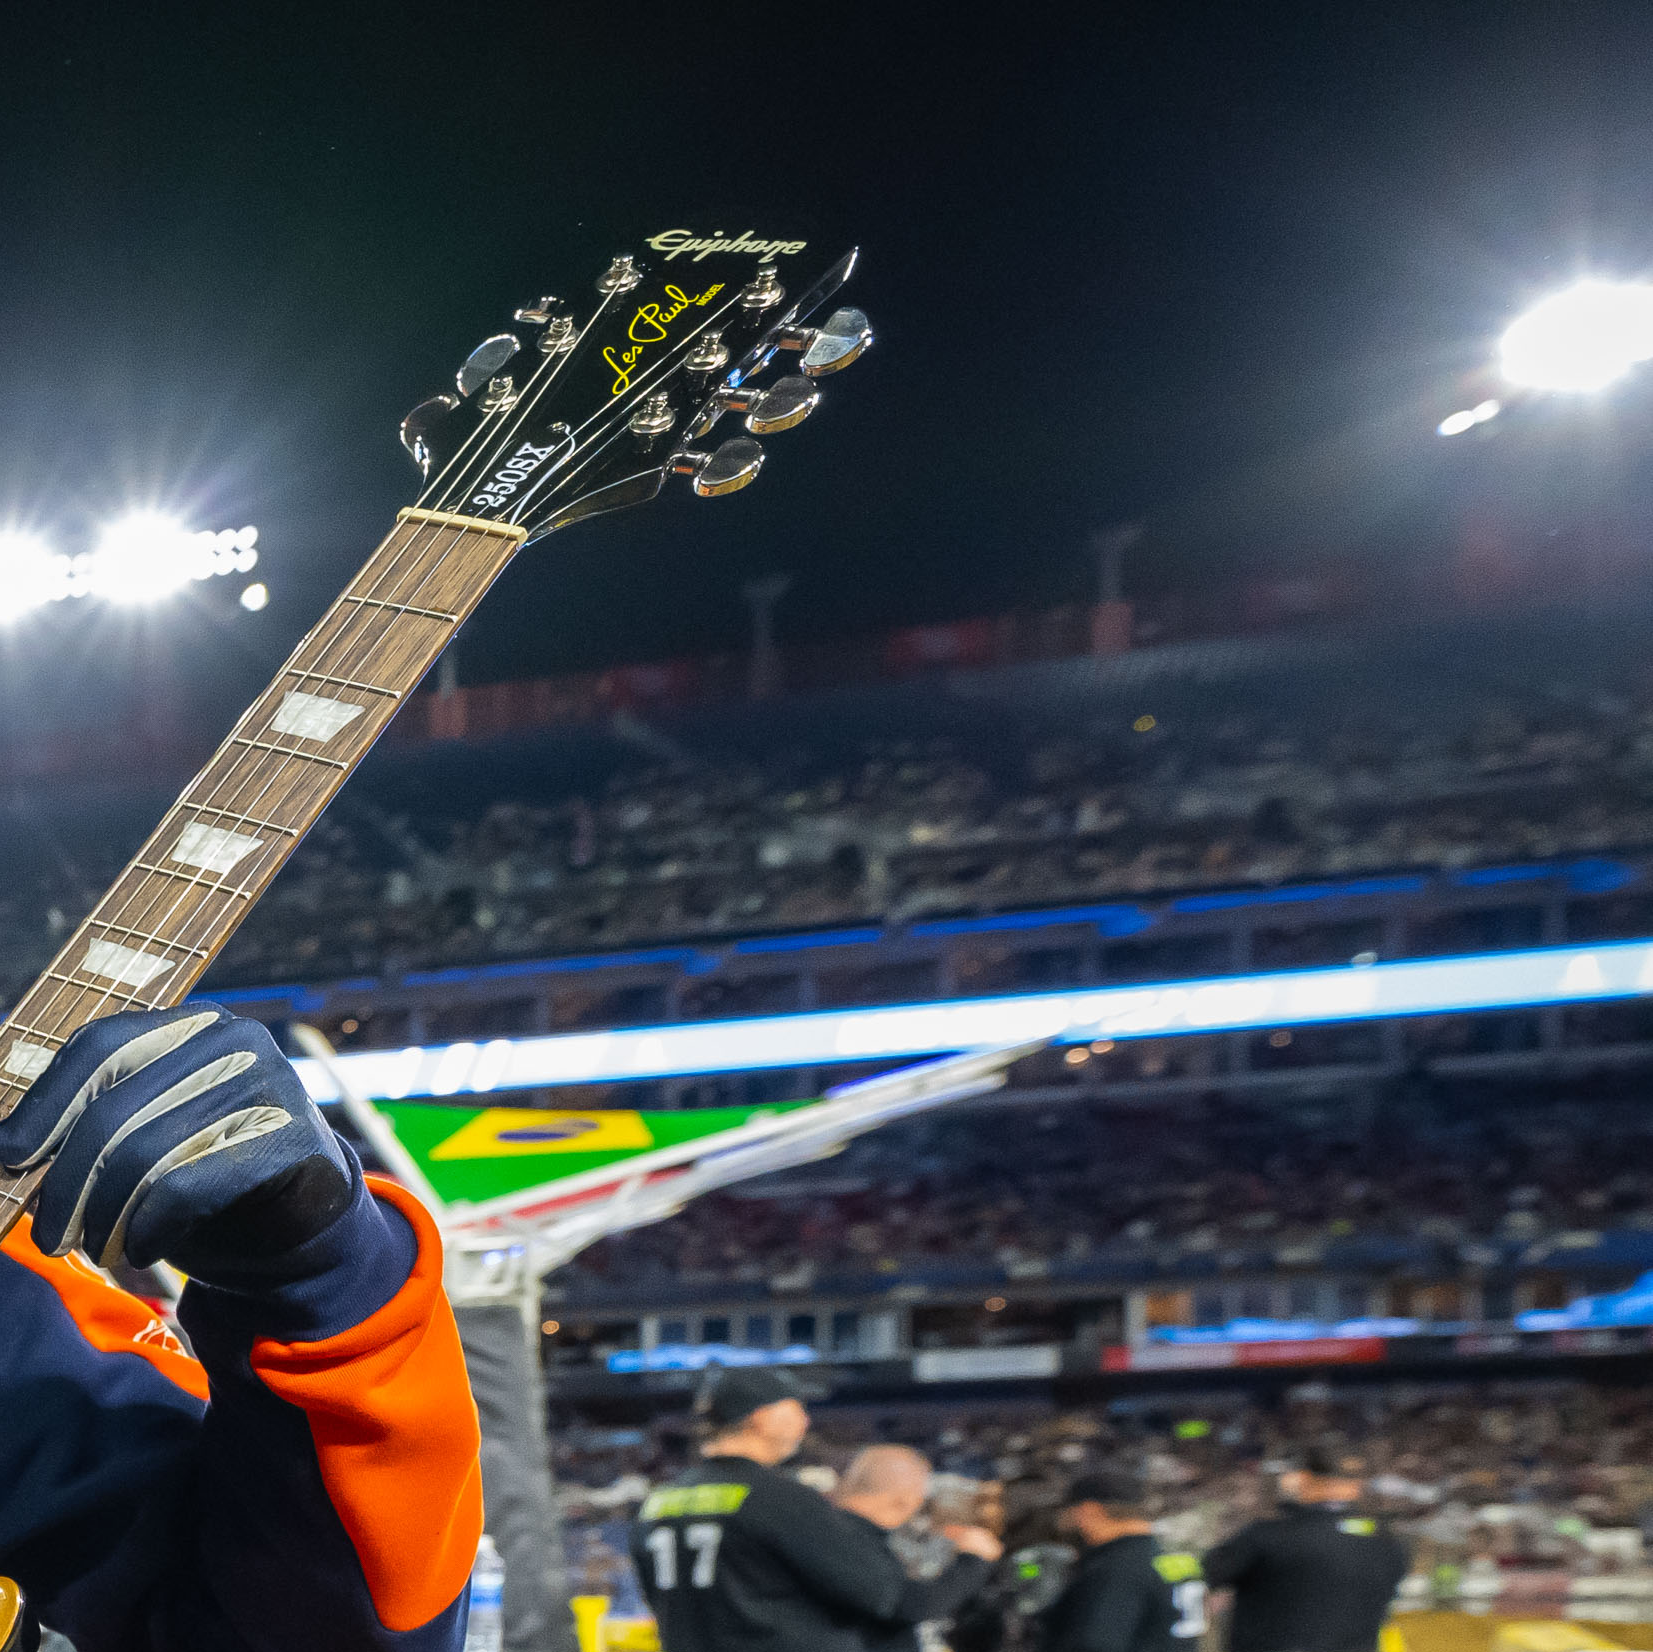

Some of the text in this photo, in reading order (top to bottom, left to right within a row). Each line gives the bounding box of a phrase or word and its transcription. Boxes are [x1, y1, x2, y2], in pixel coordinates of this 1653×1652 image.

[645, 230, 807, 263] Epiphone
[696, 283, 726, 307] MODEL
[603, 284, 701, 395] Les Paul
[473, 441, 555, 508] 250SX
[645, 1522, 724, 1591] 17
